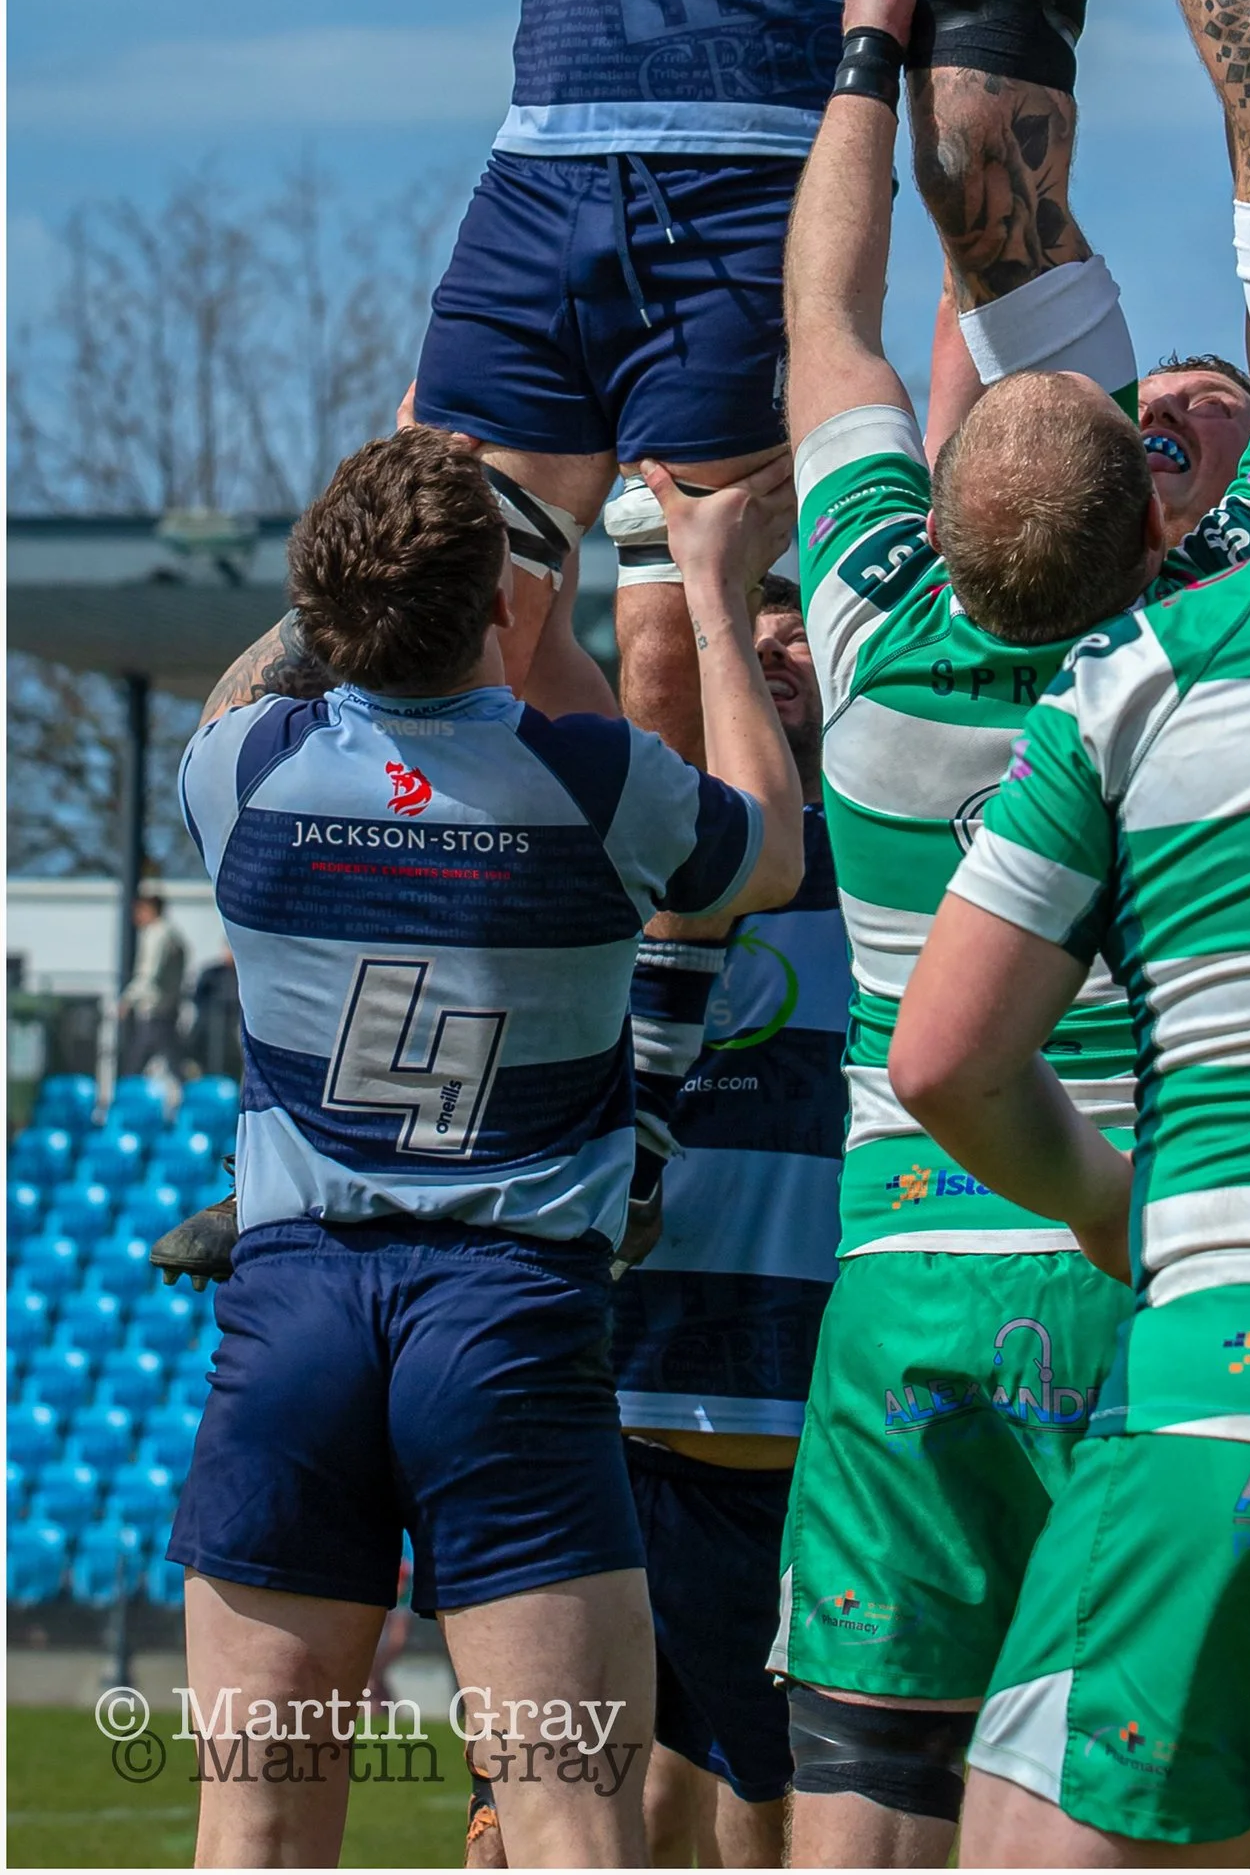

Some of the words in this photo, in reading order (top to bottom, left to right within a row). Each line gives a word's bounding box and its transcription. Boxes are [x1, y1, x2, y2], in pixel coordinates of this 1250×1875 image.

[932, 658, 1037, 707] SPR
[291, 820, 530, 855] JACKSON-STOPS
[311, 861, 376, 873] PROPERTY
[381, 865, 439, 877] EXPERTS
[442, 868, 480, 880] SINCE
[321, 953, 511, 1160] 4
[821, 1613, 879, 1635] Pharmacy
